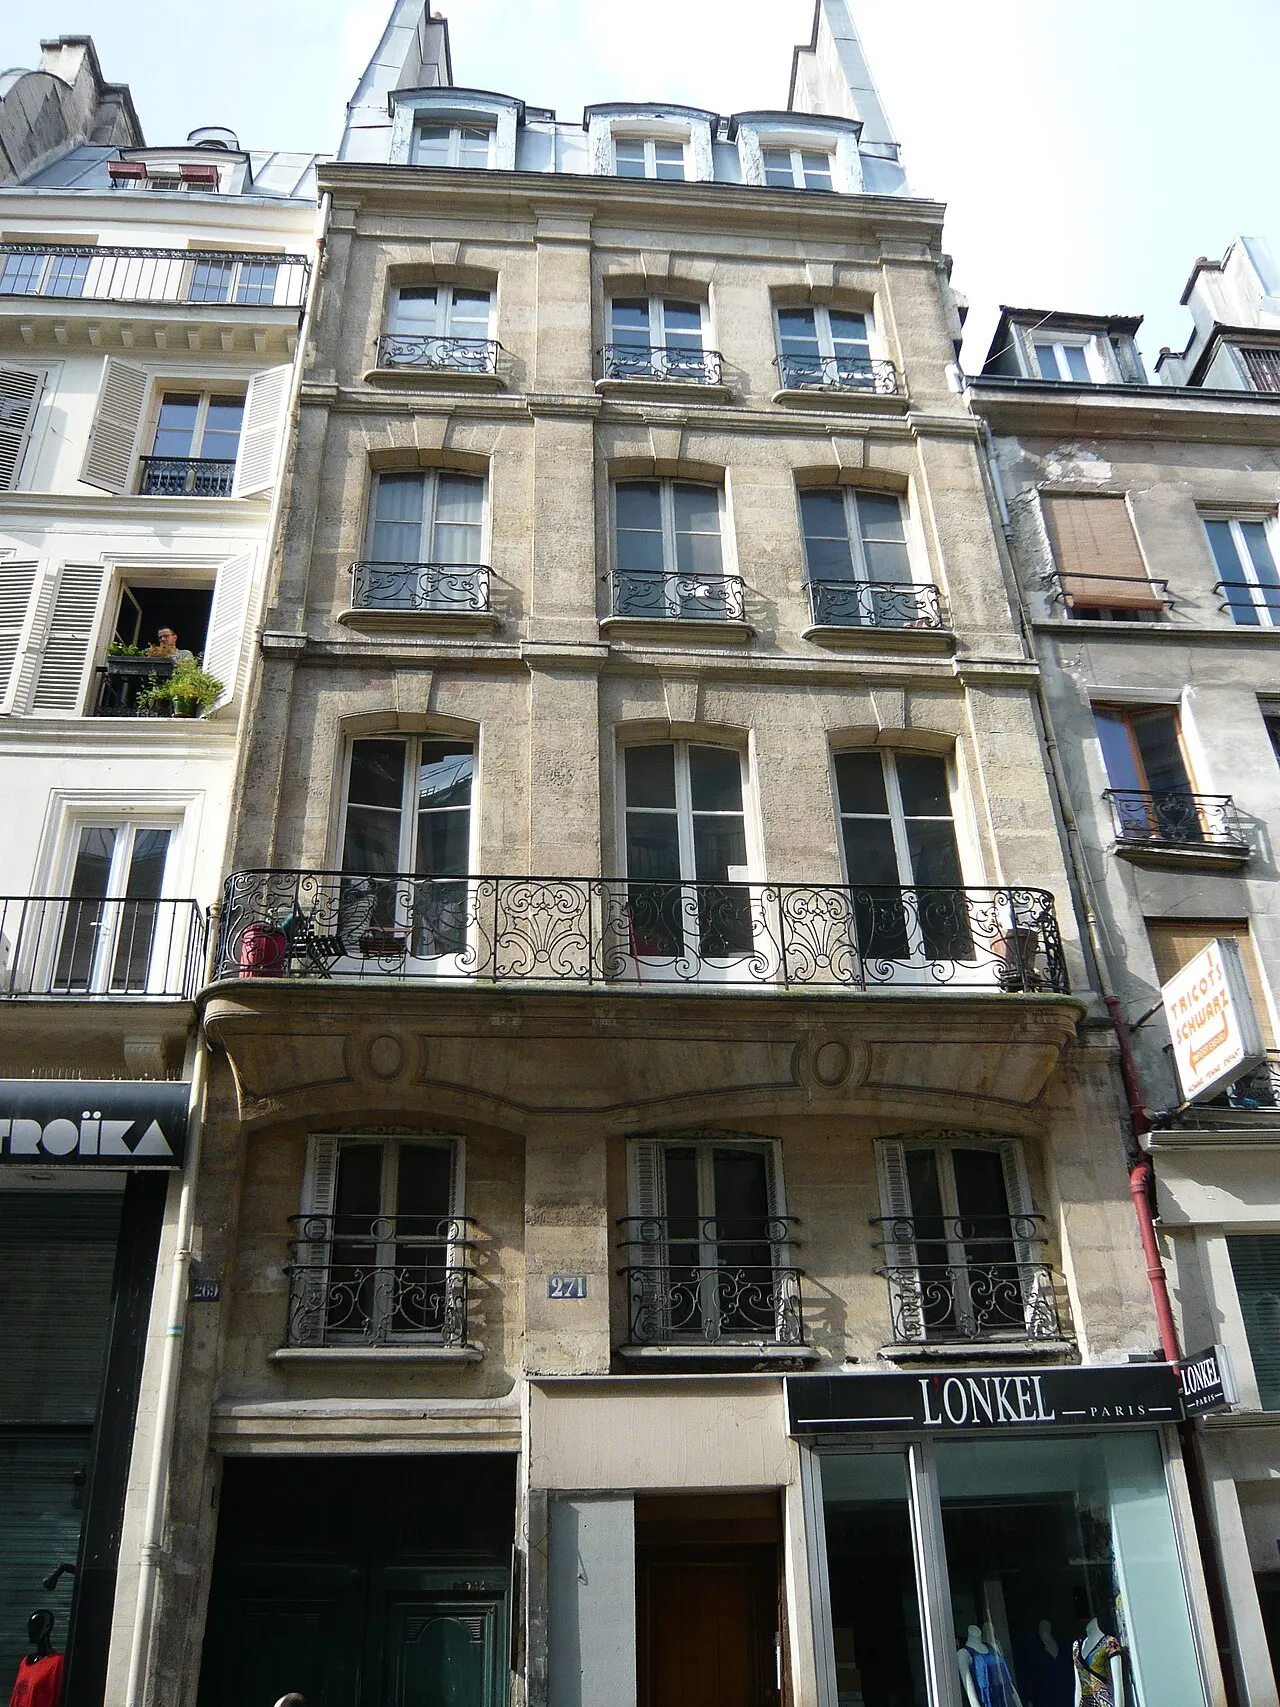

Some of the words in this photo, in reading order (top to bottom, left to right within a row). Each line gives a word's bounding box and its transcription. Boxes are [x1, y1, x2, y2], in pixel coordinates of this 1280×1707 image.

[1170, 963, 1222, 1020] TRICOTS
[1176, 988, 1229, 1044] SCHWARZ
[194, 1283, 219, 1298] 269
[551, 1277, 584, 1297] 271
[1195, 1393, 1215, 1407] PARIS
[1090, 1404, 1145, 1417] PARIS
